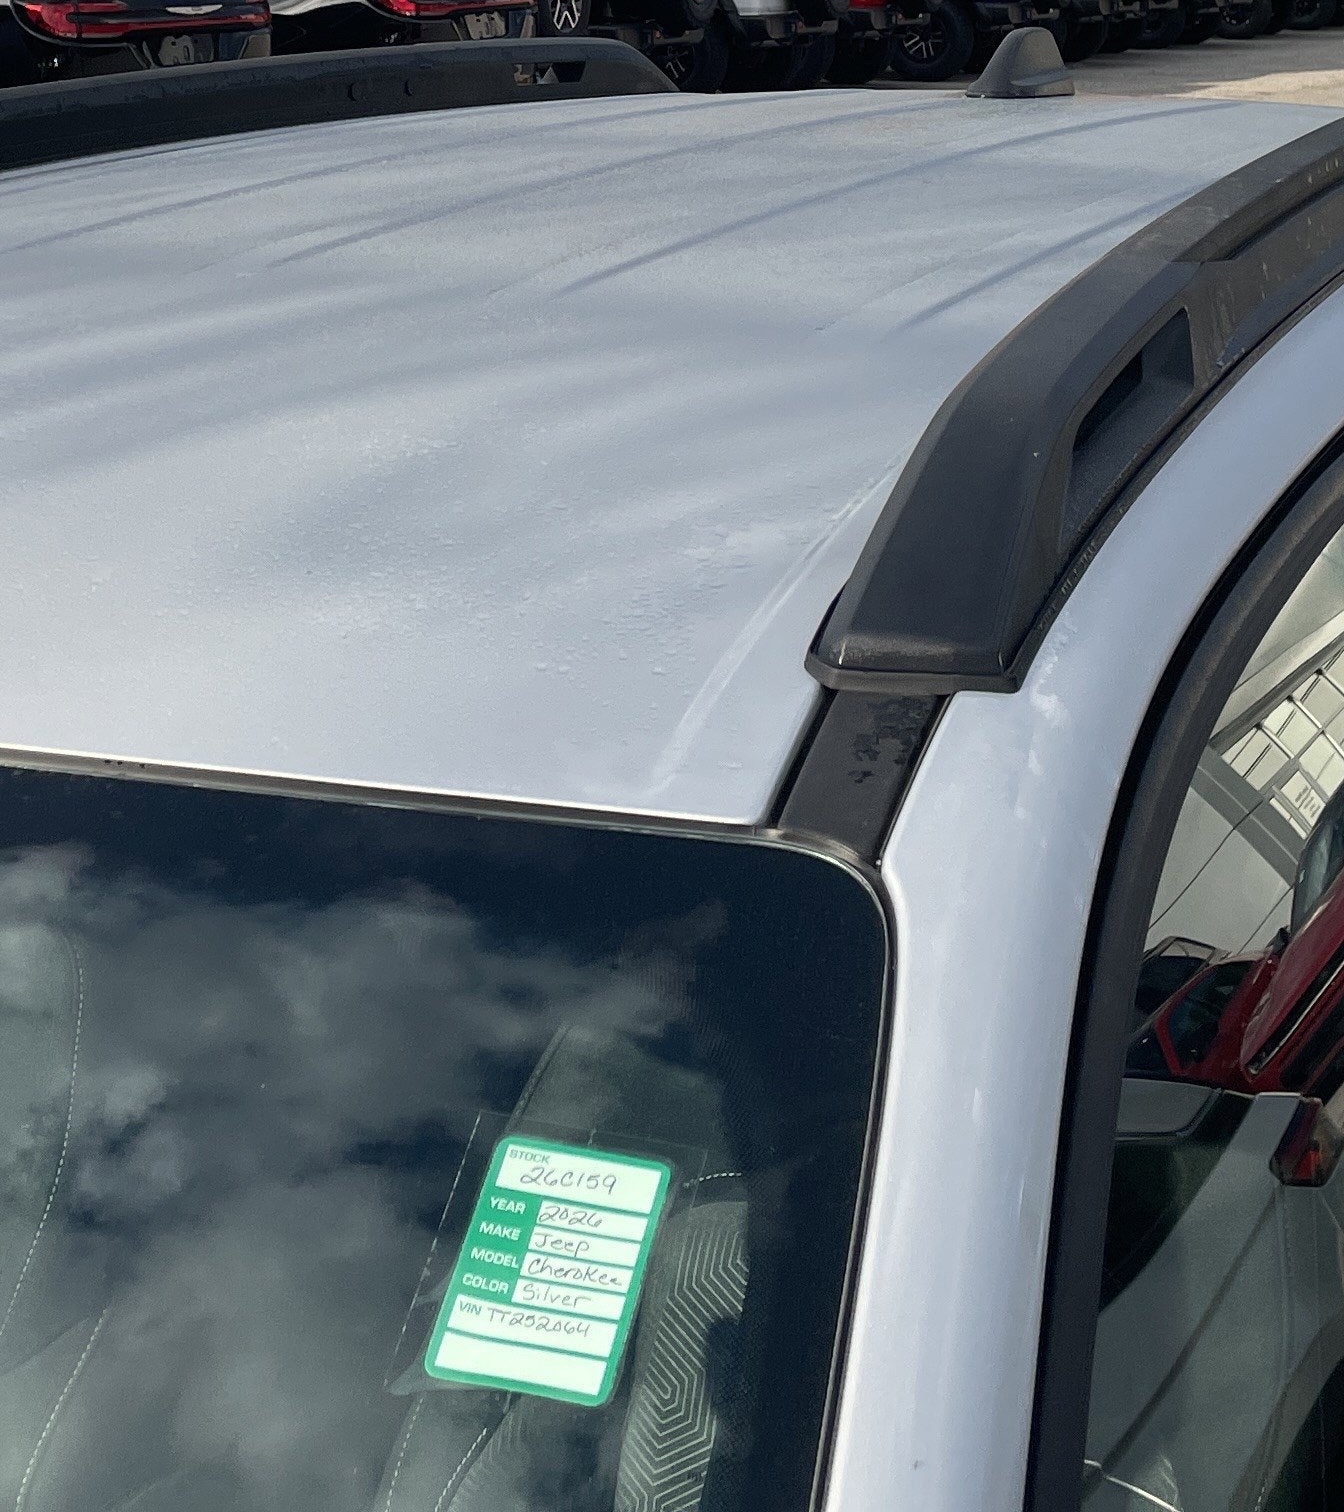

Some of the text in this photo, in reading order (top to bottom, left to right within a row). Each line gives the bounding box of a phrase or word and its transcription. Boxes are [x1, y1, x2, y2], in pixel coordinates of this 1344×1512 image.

[508, 1149, 551, 1165] STOCK
[489, 1195, 527, 1216] YEAR
[538, 1205, 604, 1230] 2026
[478, 1221, 523, 1242] MAKE
[533, 1231, 591, 1258] Jeep
[470, 1247, 520, 1270] MODEL
[461, 1272, 510, 1295] COLOR
[522, 1282, 592, 1309] Silver
[459, 1300, 483, 1316] VIN
